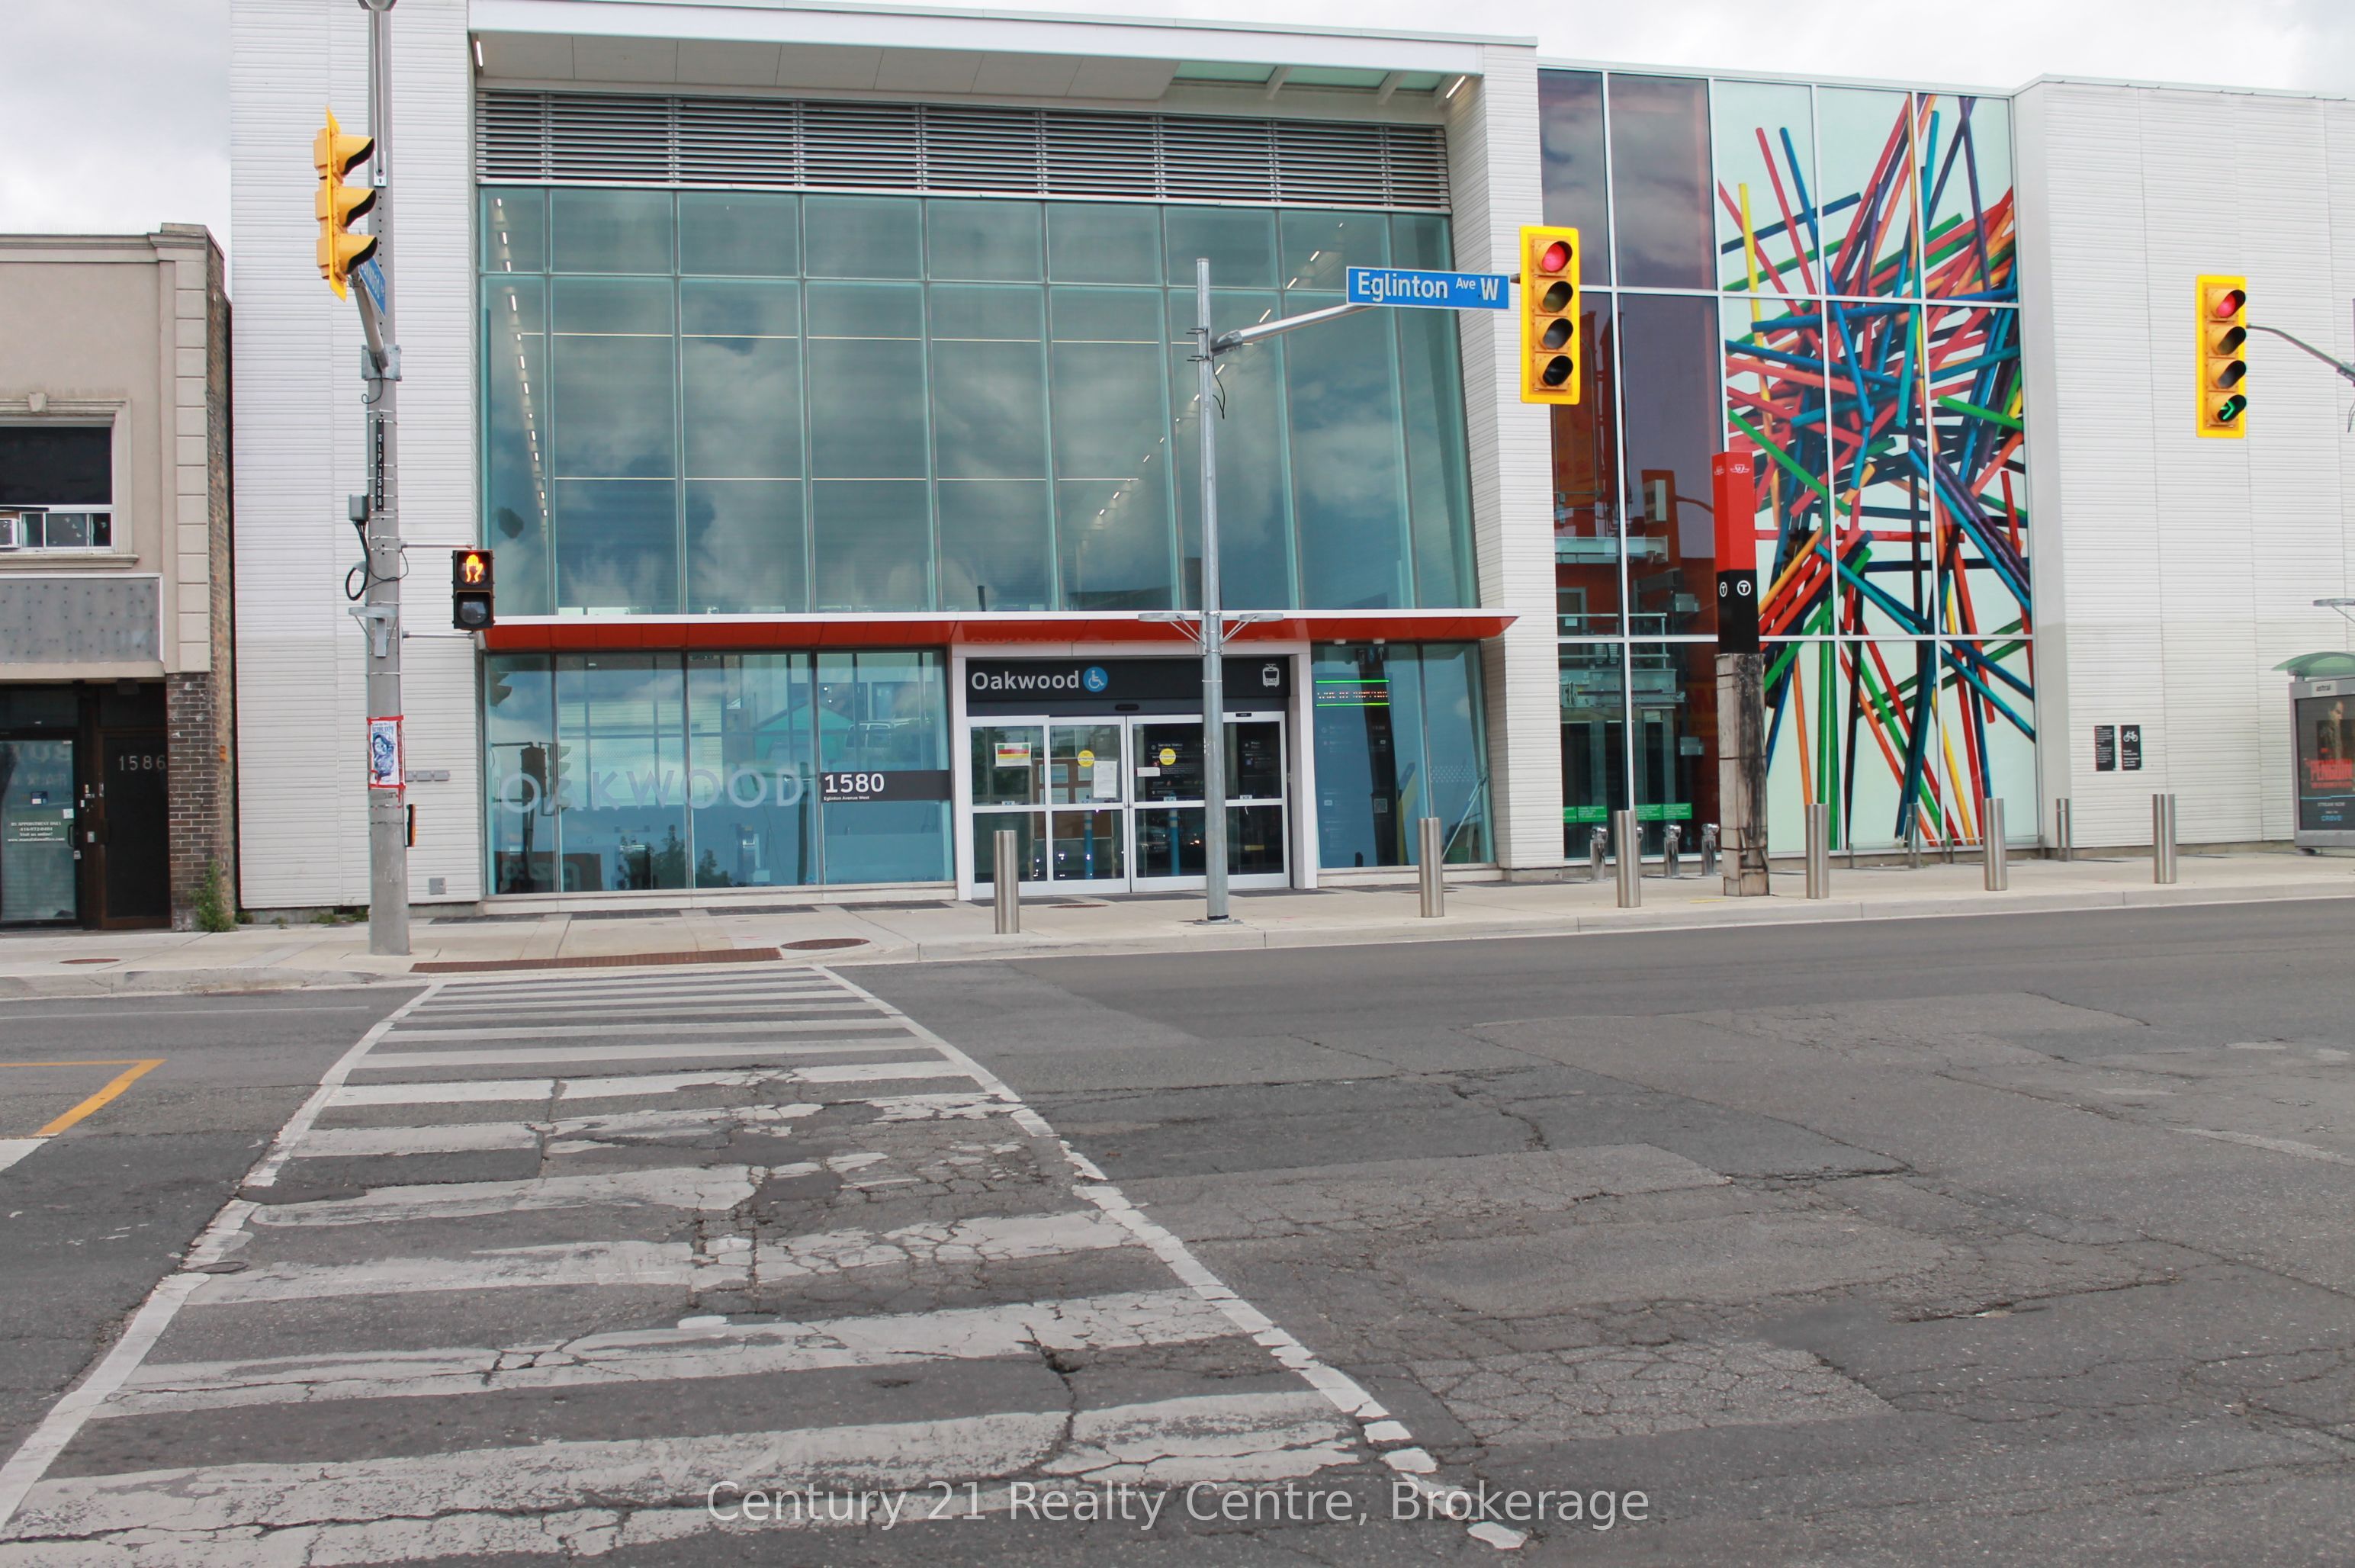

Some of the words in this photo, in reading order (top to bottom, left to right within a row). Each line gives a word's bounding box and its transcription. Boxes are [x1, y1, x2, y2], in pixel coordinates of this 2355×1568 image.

[1358, 272, 1447, 302] Eglinton
[1455, 277, 1476, 290] Ave
[1480, 278, 1499, 301] W
[972, 670, 1079, 689] Oakwood
[119, 755, 166, 771] 1586
[500, 769, 804, 813] OAKWOOD
[824, 773, 885, 793] 1580
